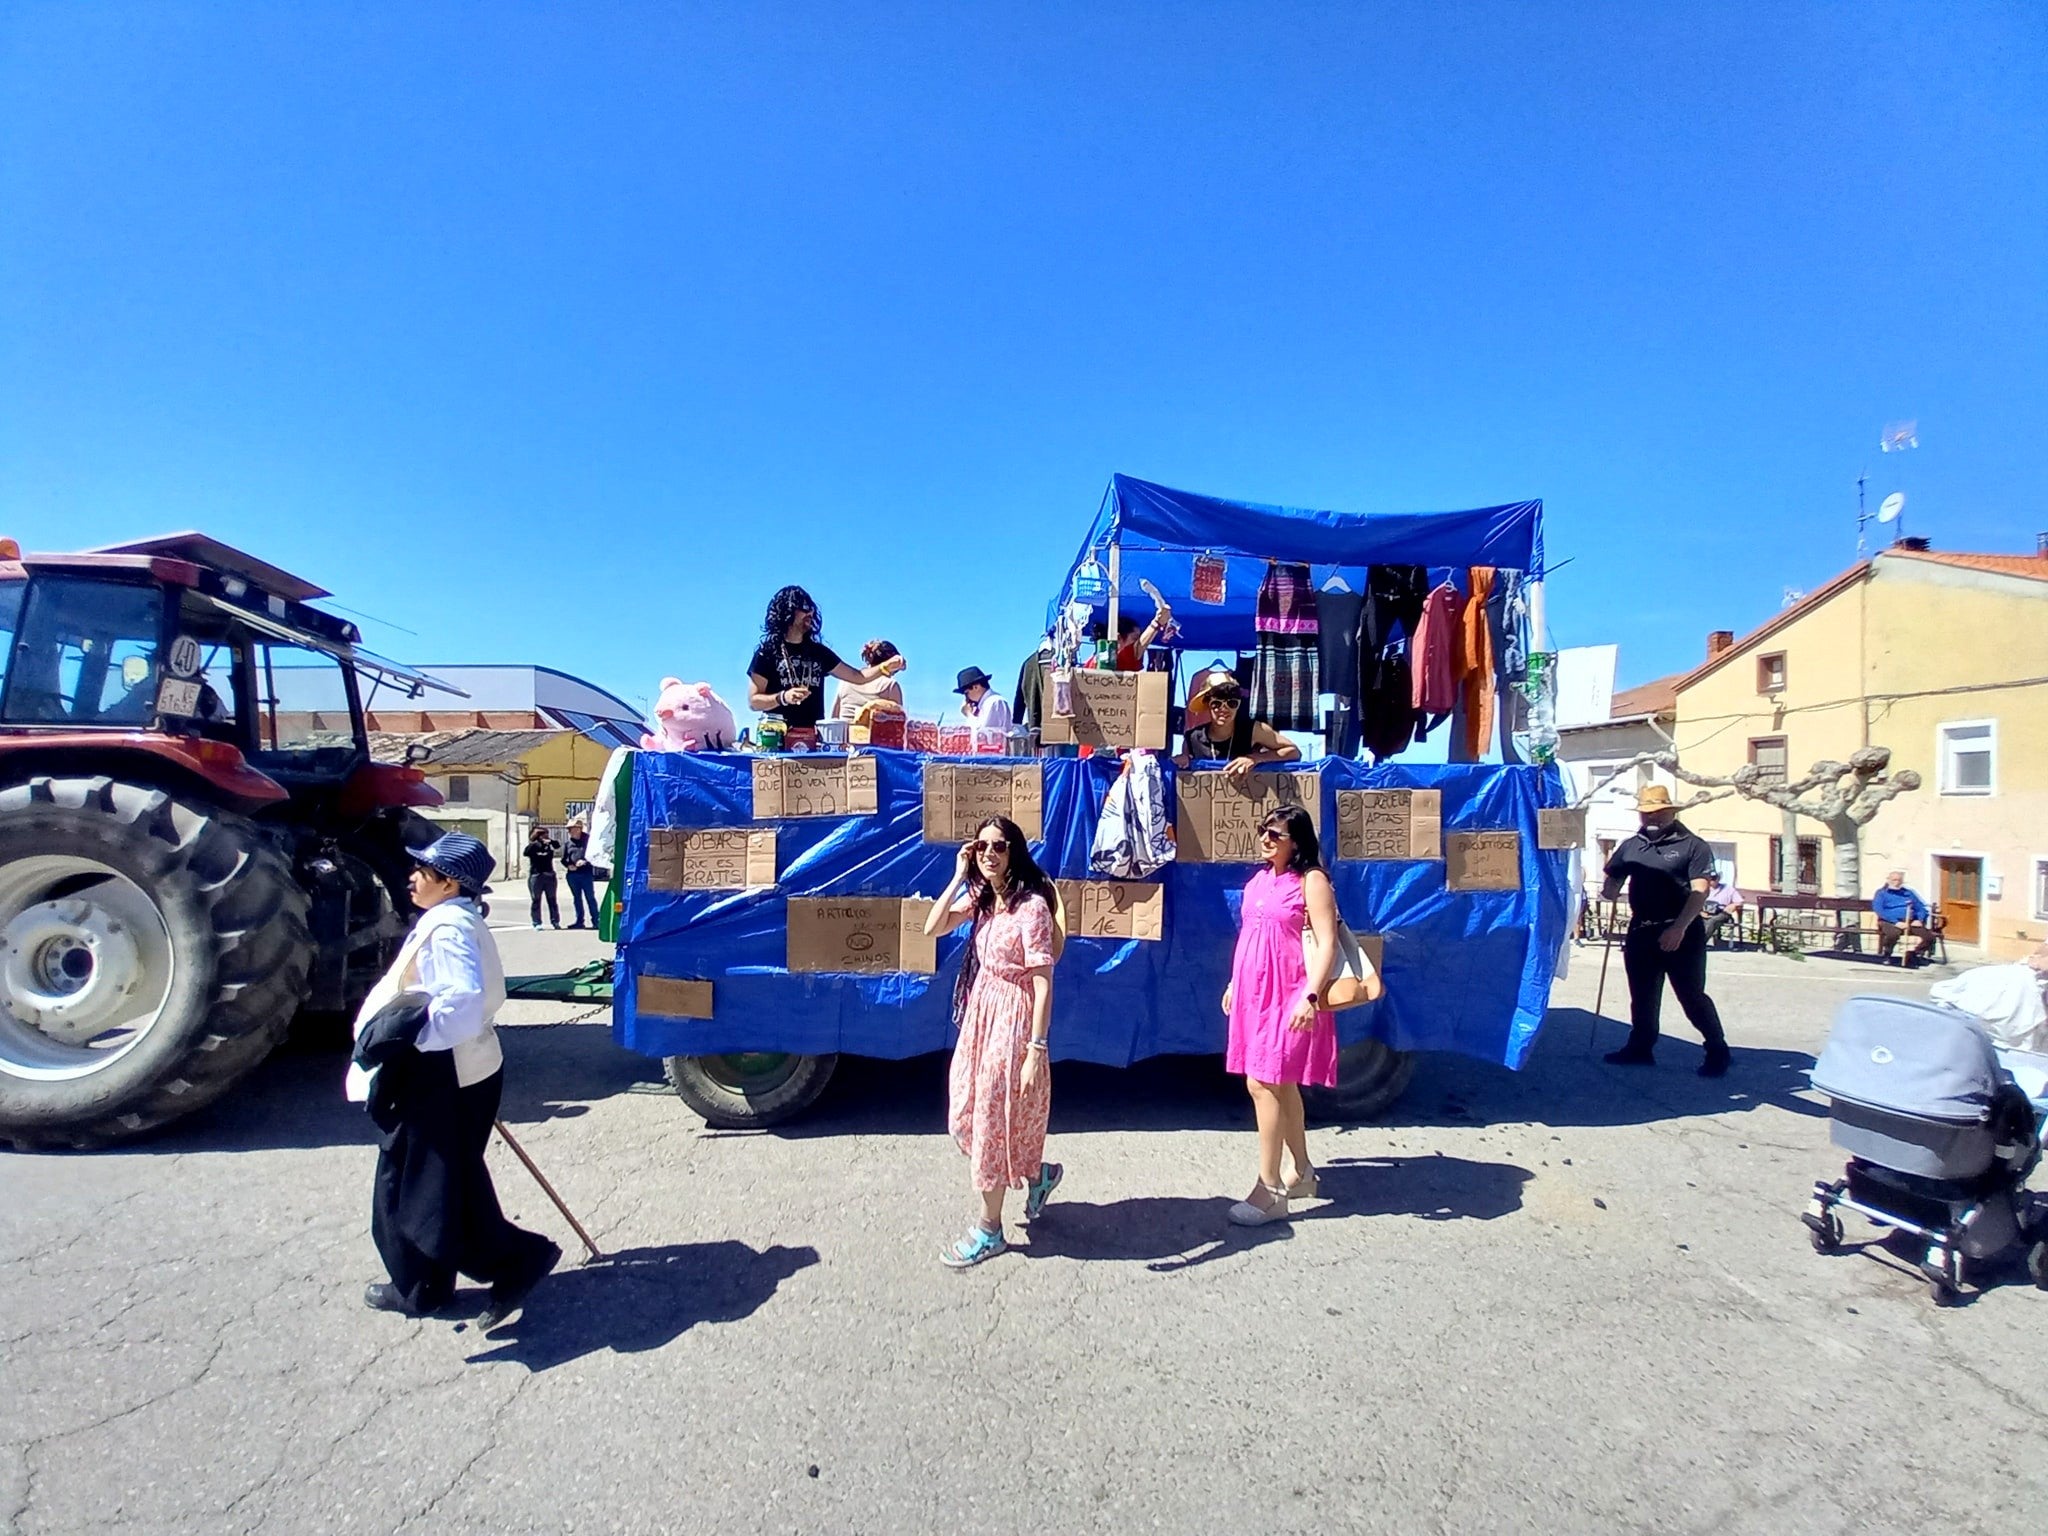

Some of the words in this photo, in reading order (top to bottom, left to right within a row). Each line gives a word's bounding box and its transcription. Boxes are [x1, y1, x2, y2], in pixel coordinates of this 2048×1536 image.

[174, 639, 196, 673] 40
[1097, 708, 1128, 718] MEDIA
[759, 779, 781, 792] QUE
[787, 778, 802, 789] LO
[807, 778, 827, 787] VEN
[1214, 800, 1243, 818] TE
[1214, 820, 1249, 830] HASTA
[1365, 811, 1404, 826] APTAS
[685, 859, 708, 869] QUE
[716, 859, 735, 868] ES
[683, 869, 743, 886] GRATIS
[1091, 916, 1119, 936] 1€
[840, 952, 892, 964] CHINOS
